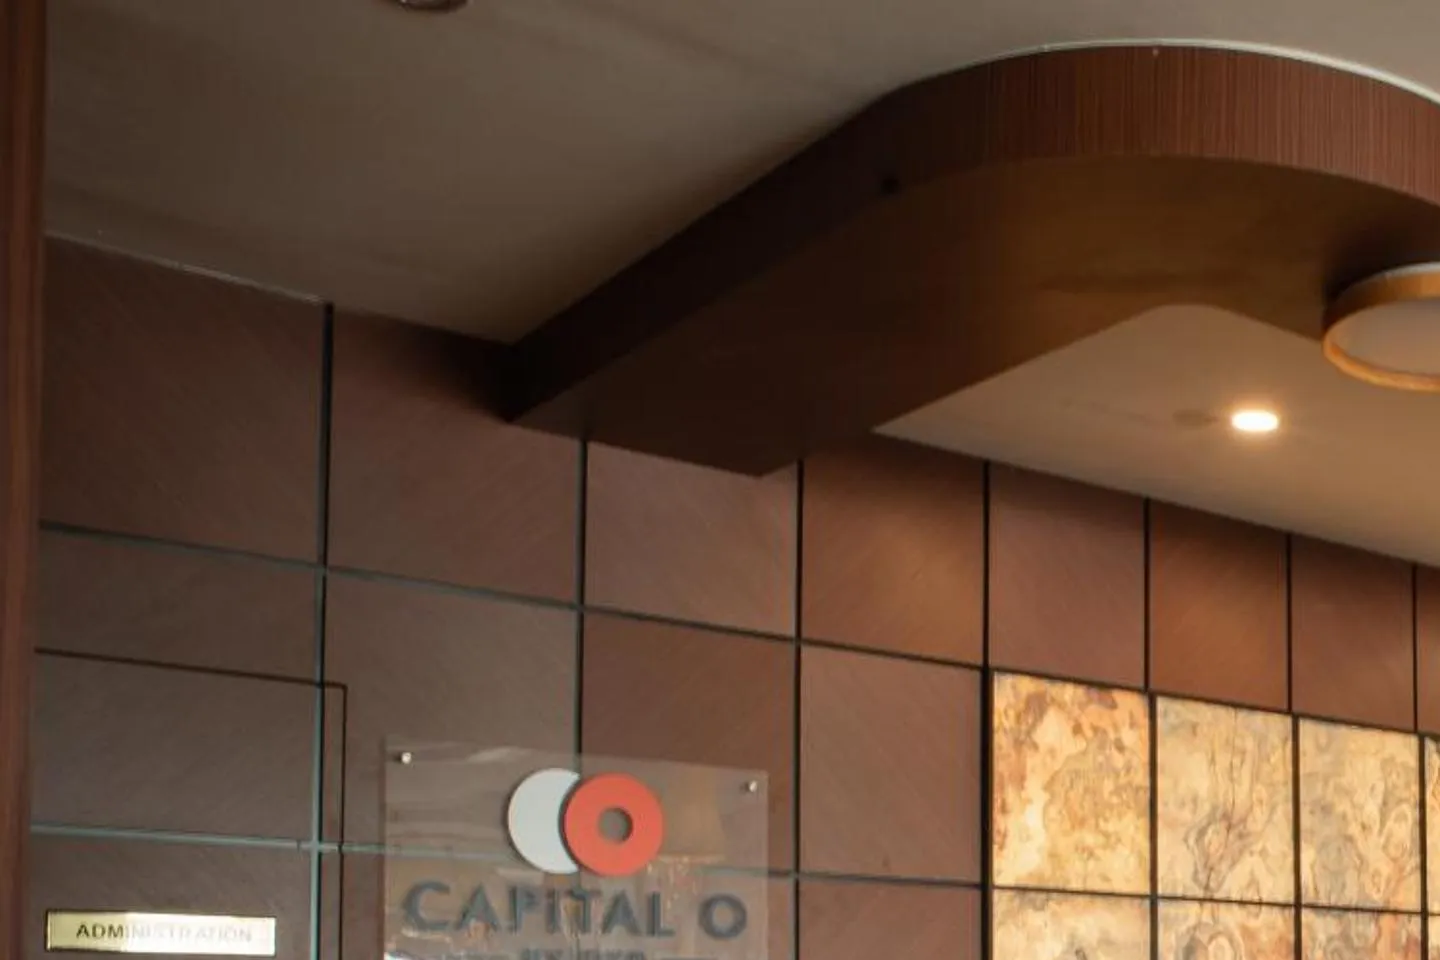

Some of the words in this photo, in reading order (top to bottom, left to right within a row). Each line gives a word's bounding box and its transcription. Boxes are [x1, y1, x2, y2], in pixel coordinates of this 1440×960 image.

[403, 880, 677, 938] CAPITAL
[700, 893, 748, 940] O
[76, 923, 252, 943] ADMINISTRATION
